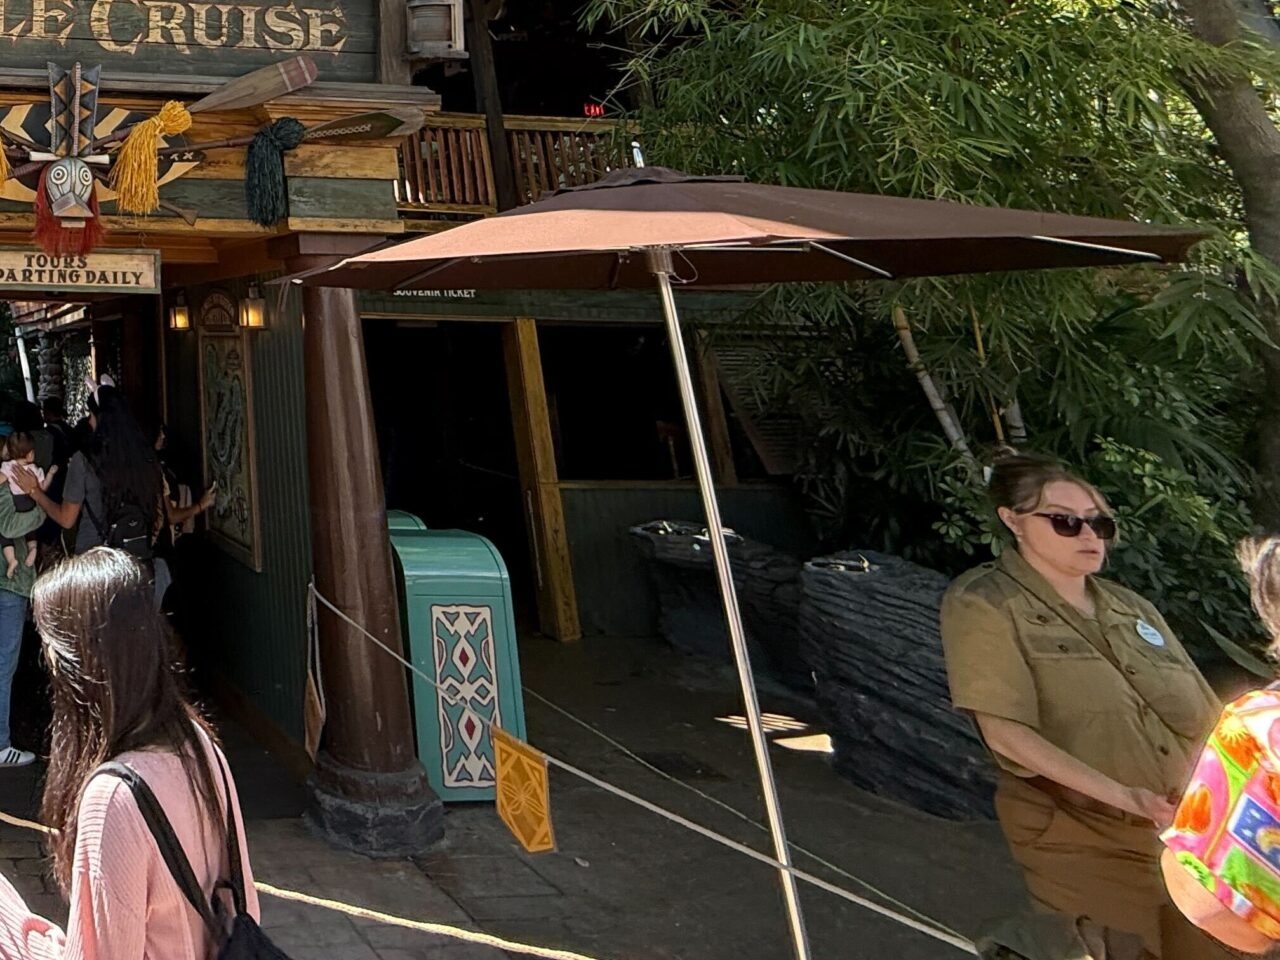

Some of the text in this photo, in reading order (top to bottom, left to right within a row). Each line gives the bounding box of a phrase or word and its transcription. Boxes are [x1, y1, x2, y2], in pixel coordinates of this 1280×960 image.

[24, 254, 88, 269] TOURS
[85, 270, 144, 285] DAILY
[444, 289, 476, 298] TICKET
